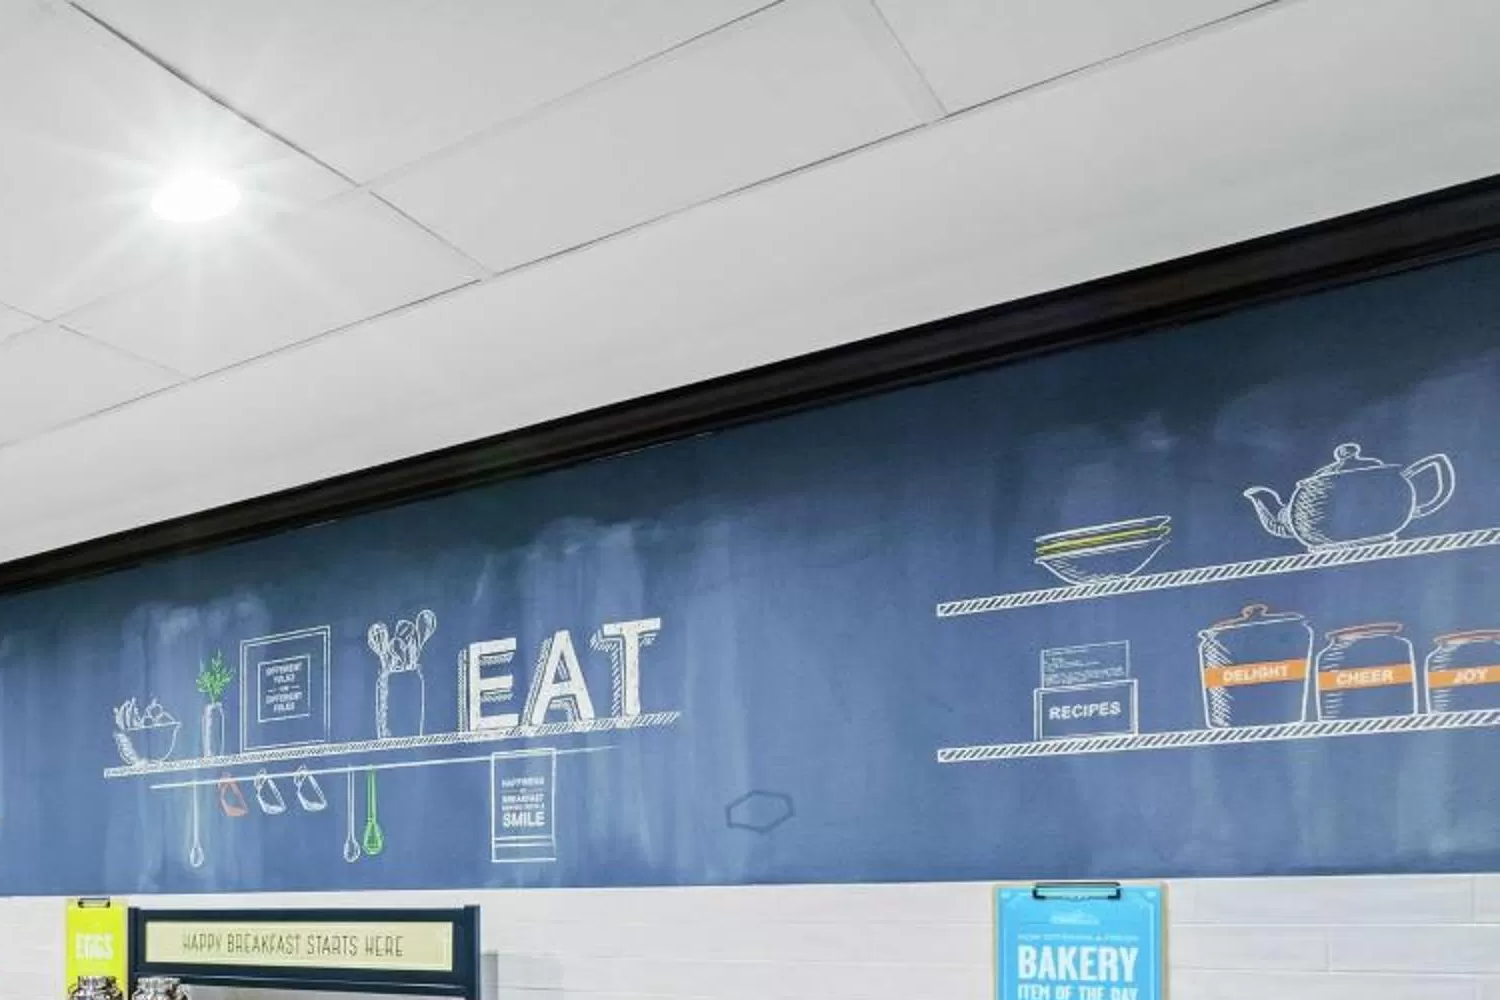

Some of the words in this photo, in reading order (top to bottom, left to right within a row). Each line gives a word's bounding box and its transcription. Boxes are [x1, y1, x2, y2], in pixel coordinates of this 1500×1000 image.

[460, 617, 661, 731] EAT
[1222, 665, 1290, 682] DELIGHT
[1336, 669, 1395, 687] CHEER
[1454, 668, 1489, 684] JOY
[1049, 700, 1122, 720] RECIPES
[502, 811, 545, 828] SMILE
[76, 933, 114, 959] EGGS
[182, 932, 222, 953] HAPPY
[227, 933, 301, 955] BREAKFAST
[307, 935, 358, 956] STARTS
[365, 935, 405, 957] HERE
[1017, 944, 1139, 982] BAKERY
